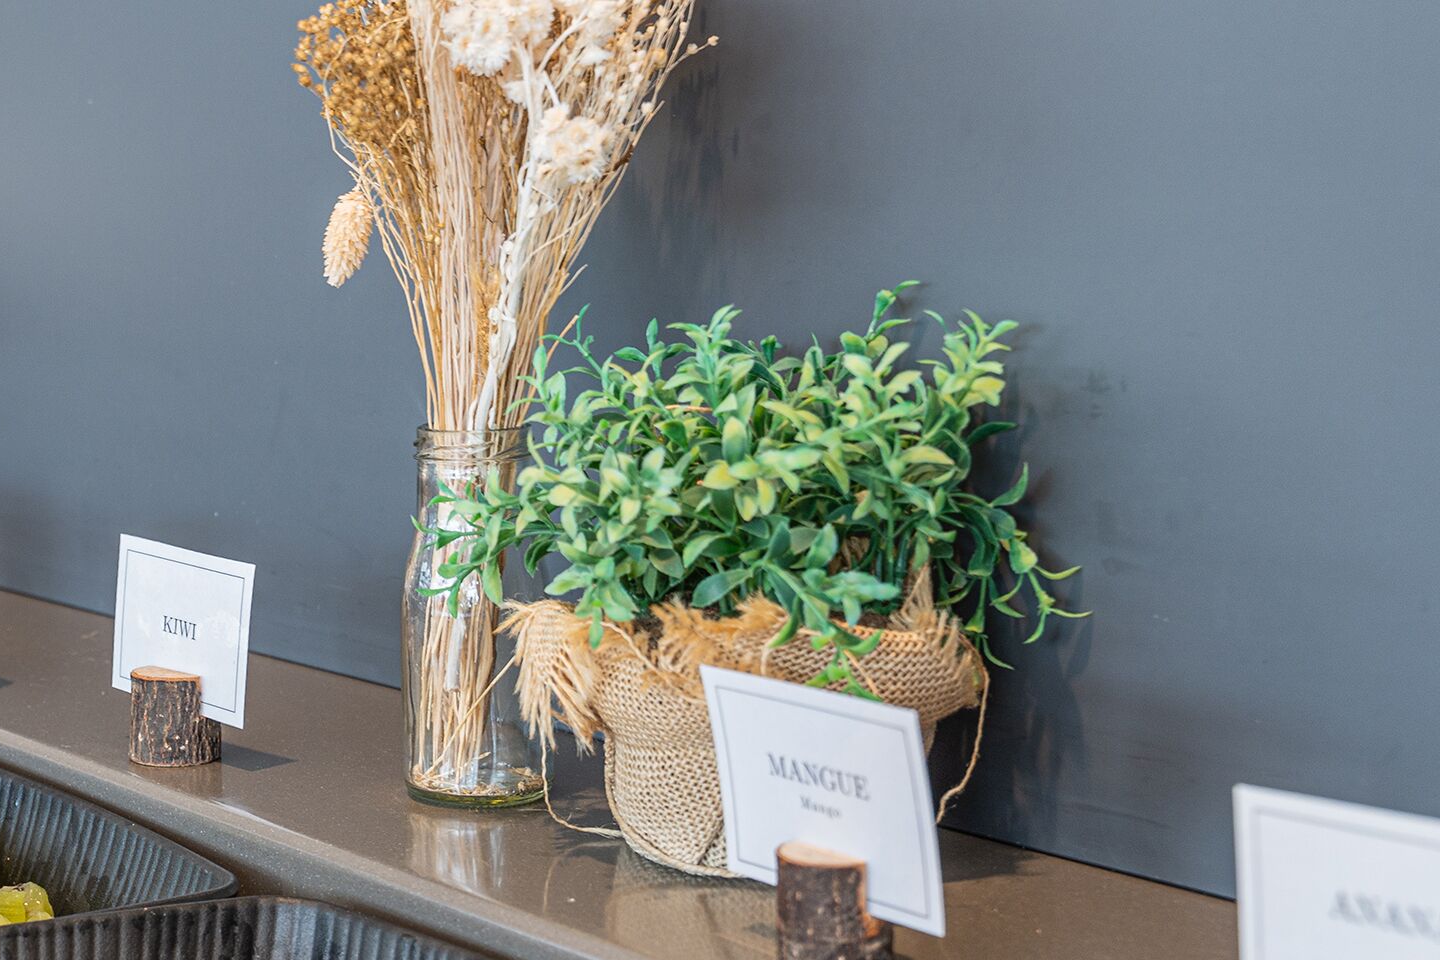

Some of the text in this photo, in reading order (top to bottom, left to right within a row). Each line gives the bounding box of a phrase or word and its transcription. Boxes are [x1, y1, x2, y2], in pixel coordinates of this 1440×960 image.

[162, 615, 197, 641] KIWI
[766, 751, 871, 802] MANGUE
[1328, 889, 1440, 945] ANAN
